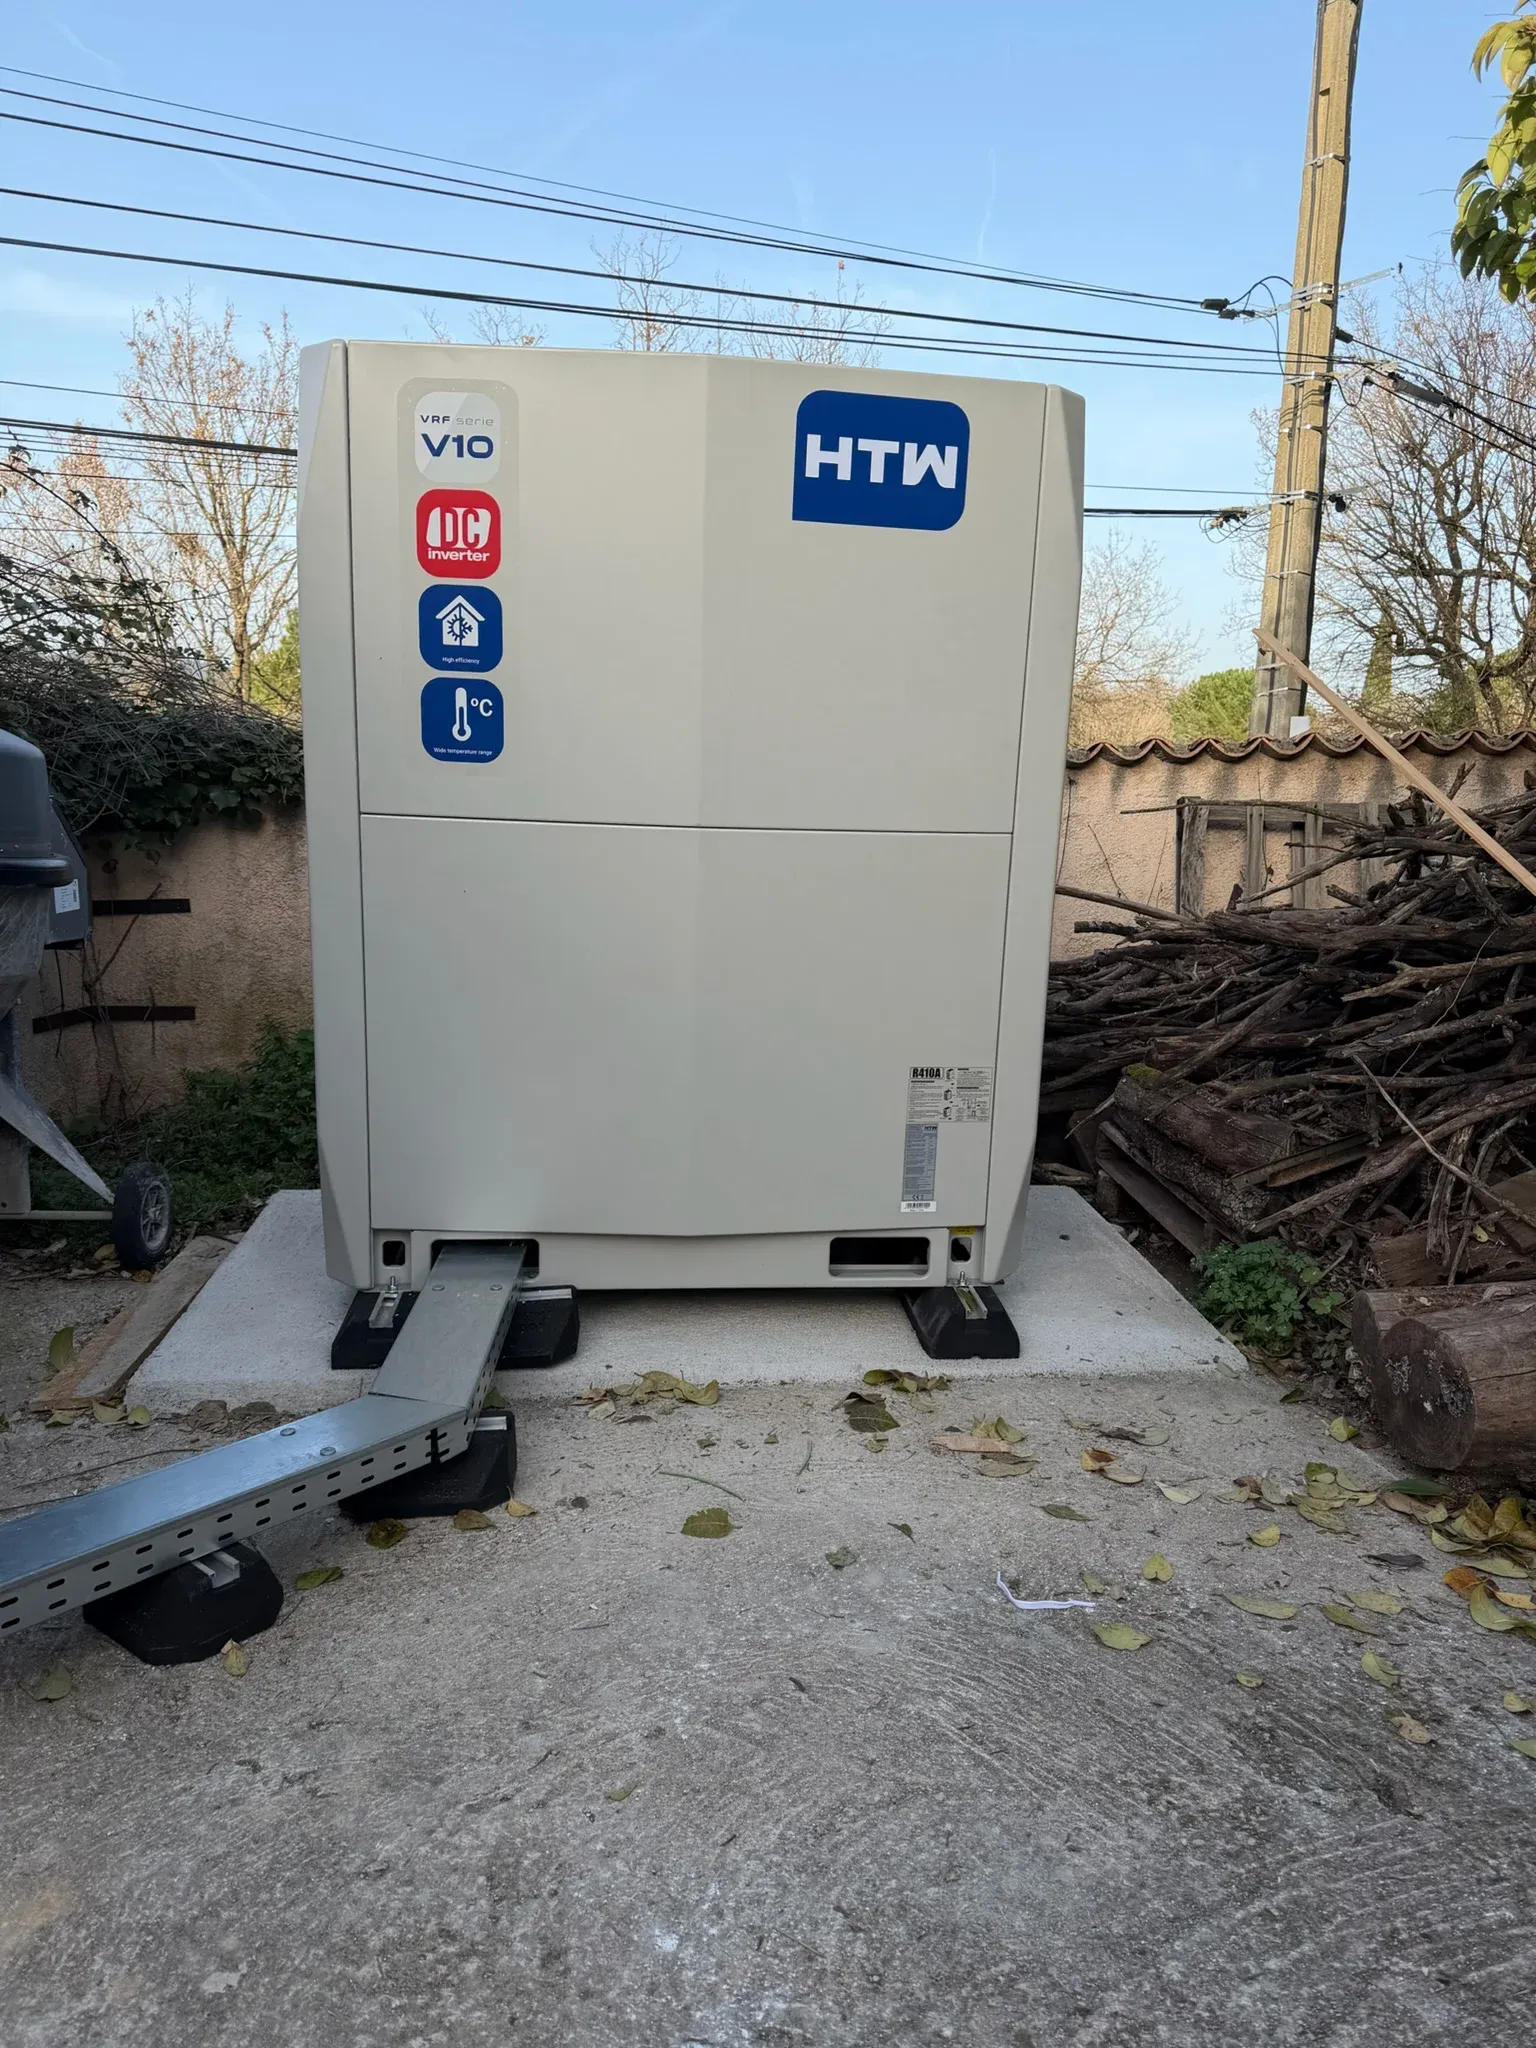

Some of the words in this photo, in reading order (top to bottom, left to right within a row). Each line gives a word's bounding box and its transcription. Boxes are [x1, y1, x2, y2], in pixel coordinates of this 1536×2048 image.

[420, 415, 451, 424] VRF
[456, 416, 494, 427] serie
[421, 433, 495, 459] V10
[805, 433, 959, 489] HTW
[430, 506, 488, 549] DC
[427, 547, 490, 562] inverter
[442, 656, 455, 664] High
[455, 656, 480, 665] efficiency
[470, 697, 493, 717] °C
[433, 746, 446, 754] Wide
[447, 747, 477, 756] temperature
[478, 749, 492, 757] range
[912, 1067, 941, 1079] R410A
